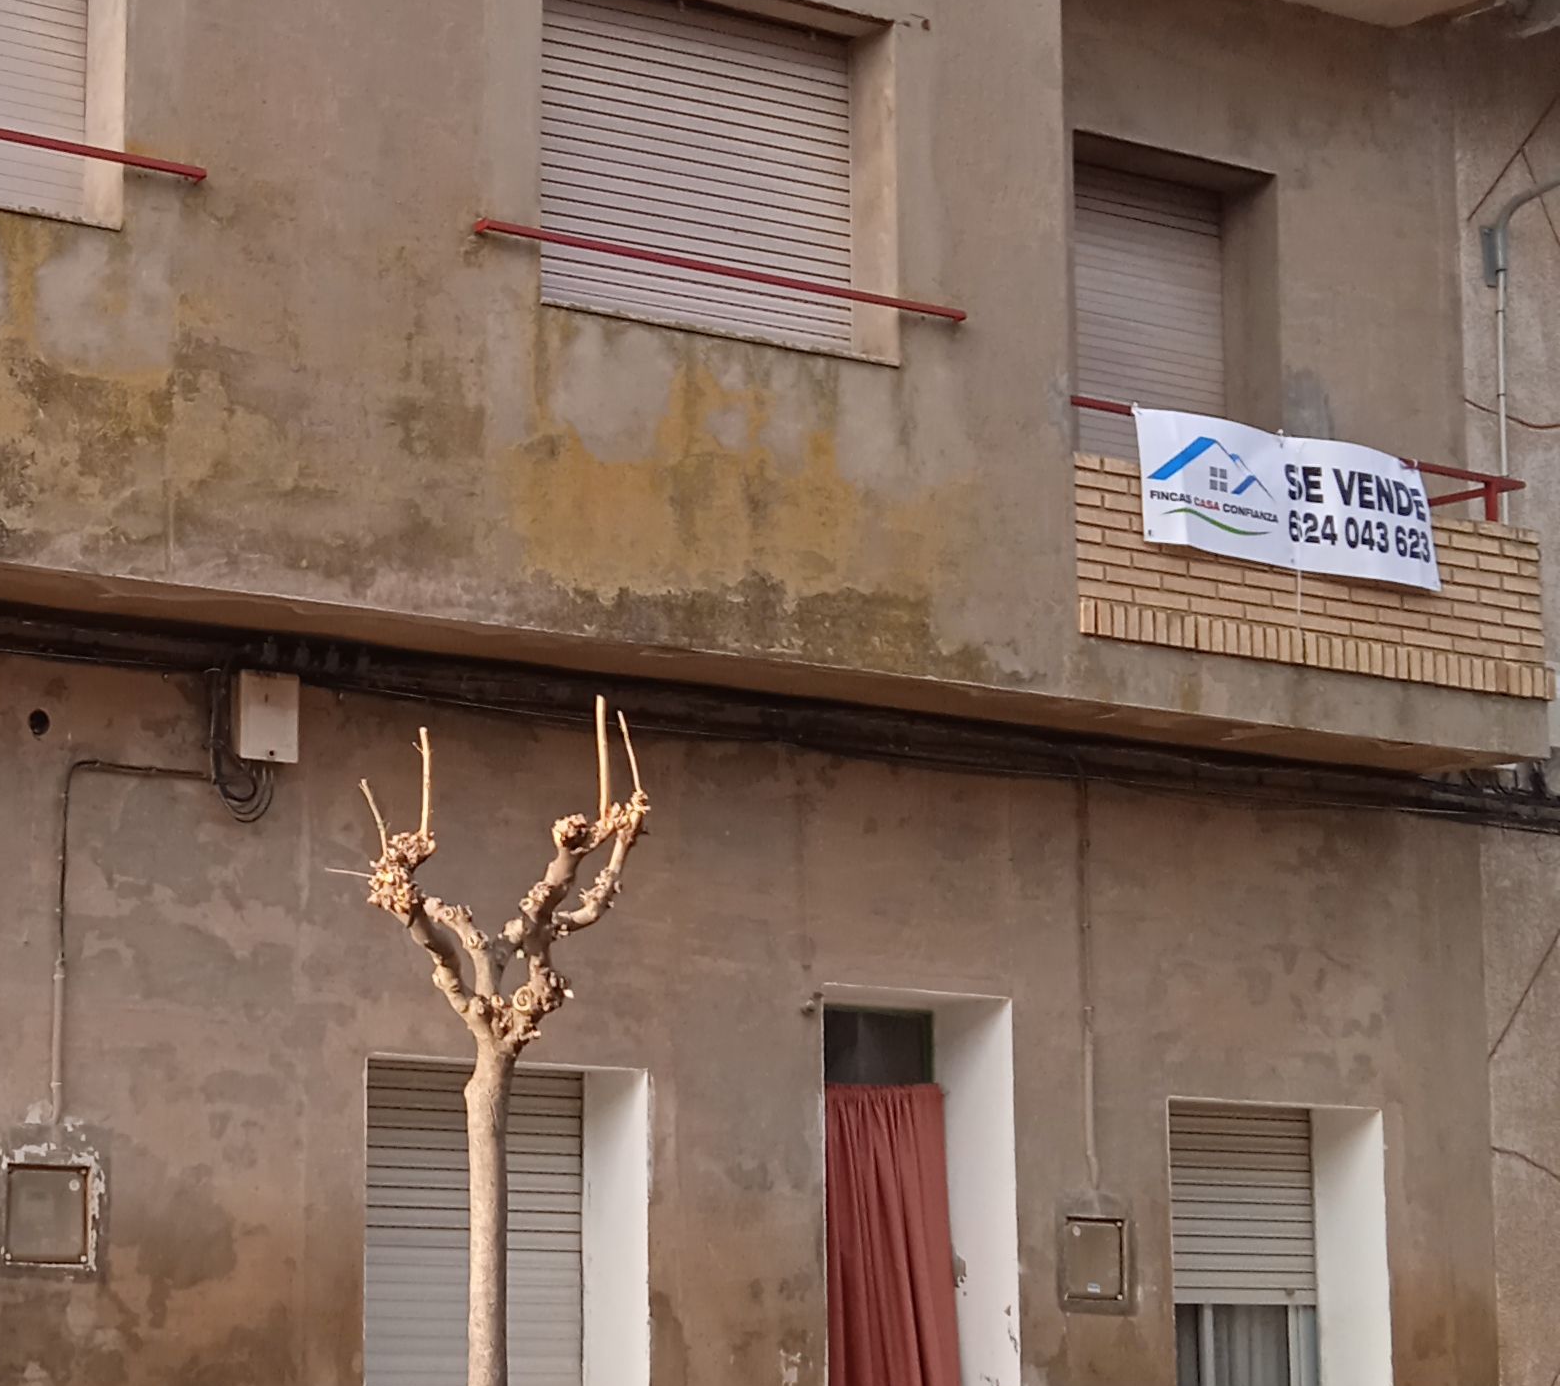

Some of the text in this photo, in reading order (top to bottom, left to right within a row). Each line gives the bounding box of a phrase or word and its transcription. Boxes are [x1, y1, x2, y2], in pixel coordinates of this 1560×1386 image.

[1149, 489, 1279, 523] FINCAS CASA CONFIANZA
[1285, 463, 1427, 523] SE VENDE
[1288, 509, 1431, 564] 624 043 623
